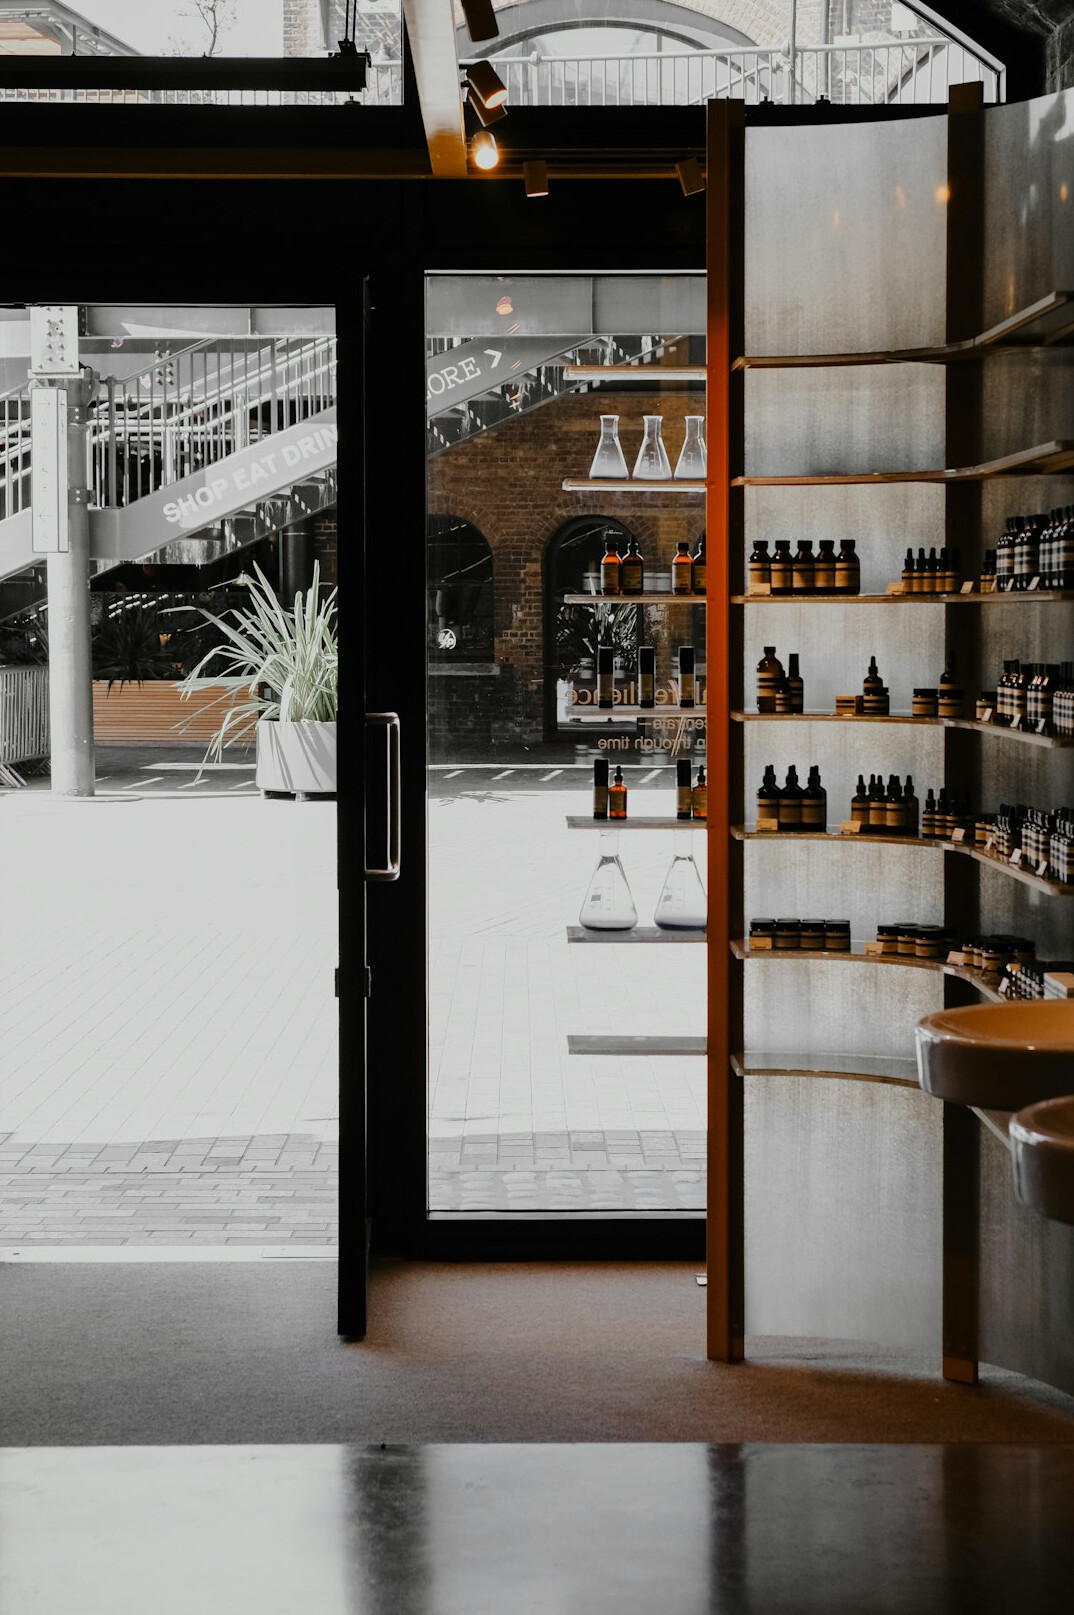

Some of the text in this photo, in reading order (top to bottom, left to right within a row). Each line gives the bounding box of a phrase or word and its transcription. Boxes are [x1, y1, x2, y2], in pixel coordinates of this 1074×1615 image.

[162, 478, 229, 523] SHOP
[232, 453, 278, 490] EAT
[426, 356, 482, 400] ORE
